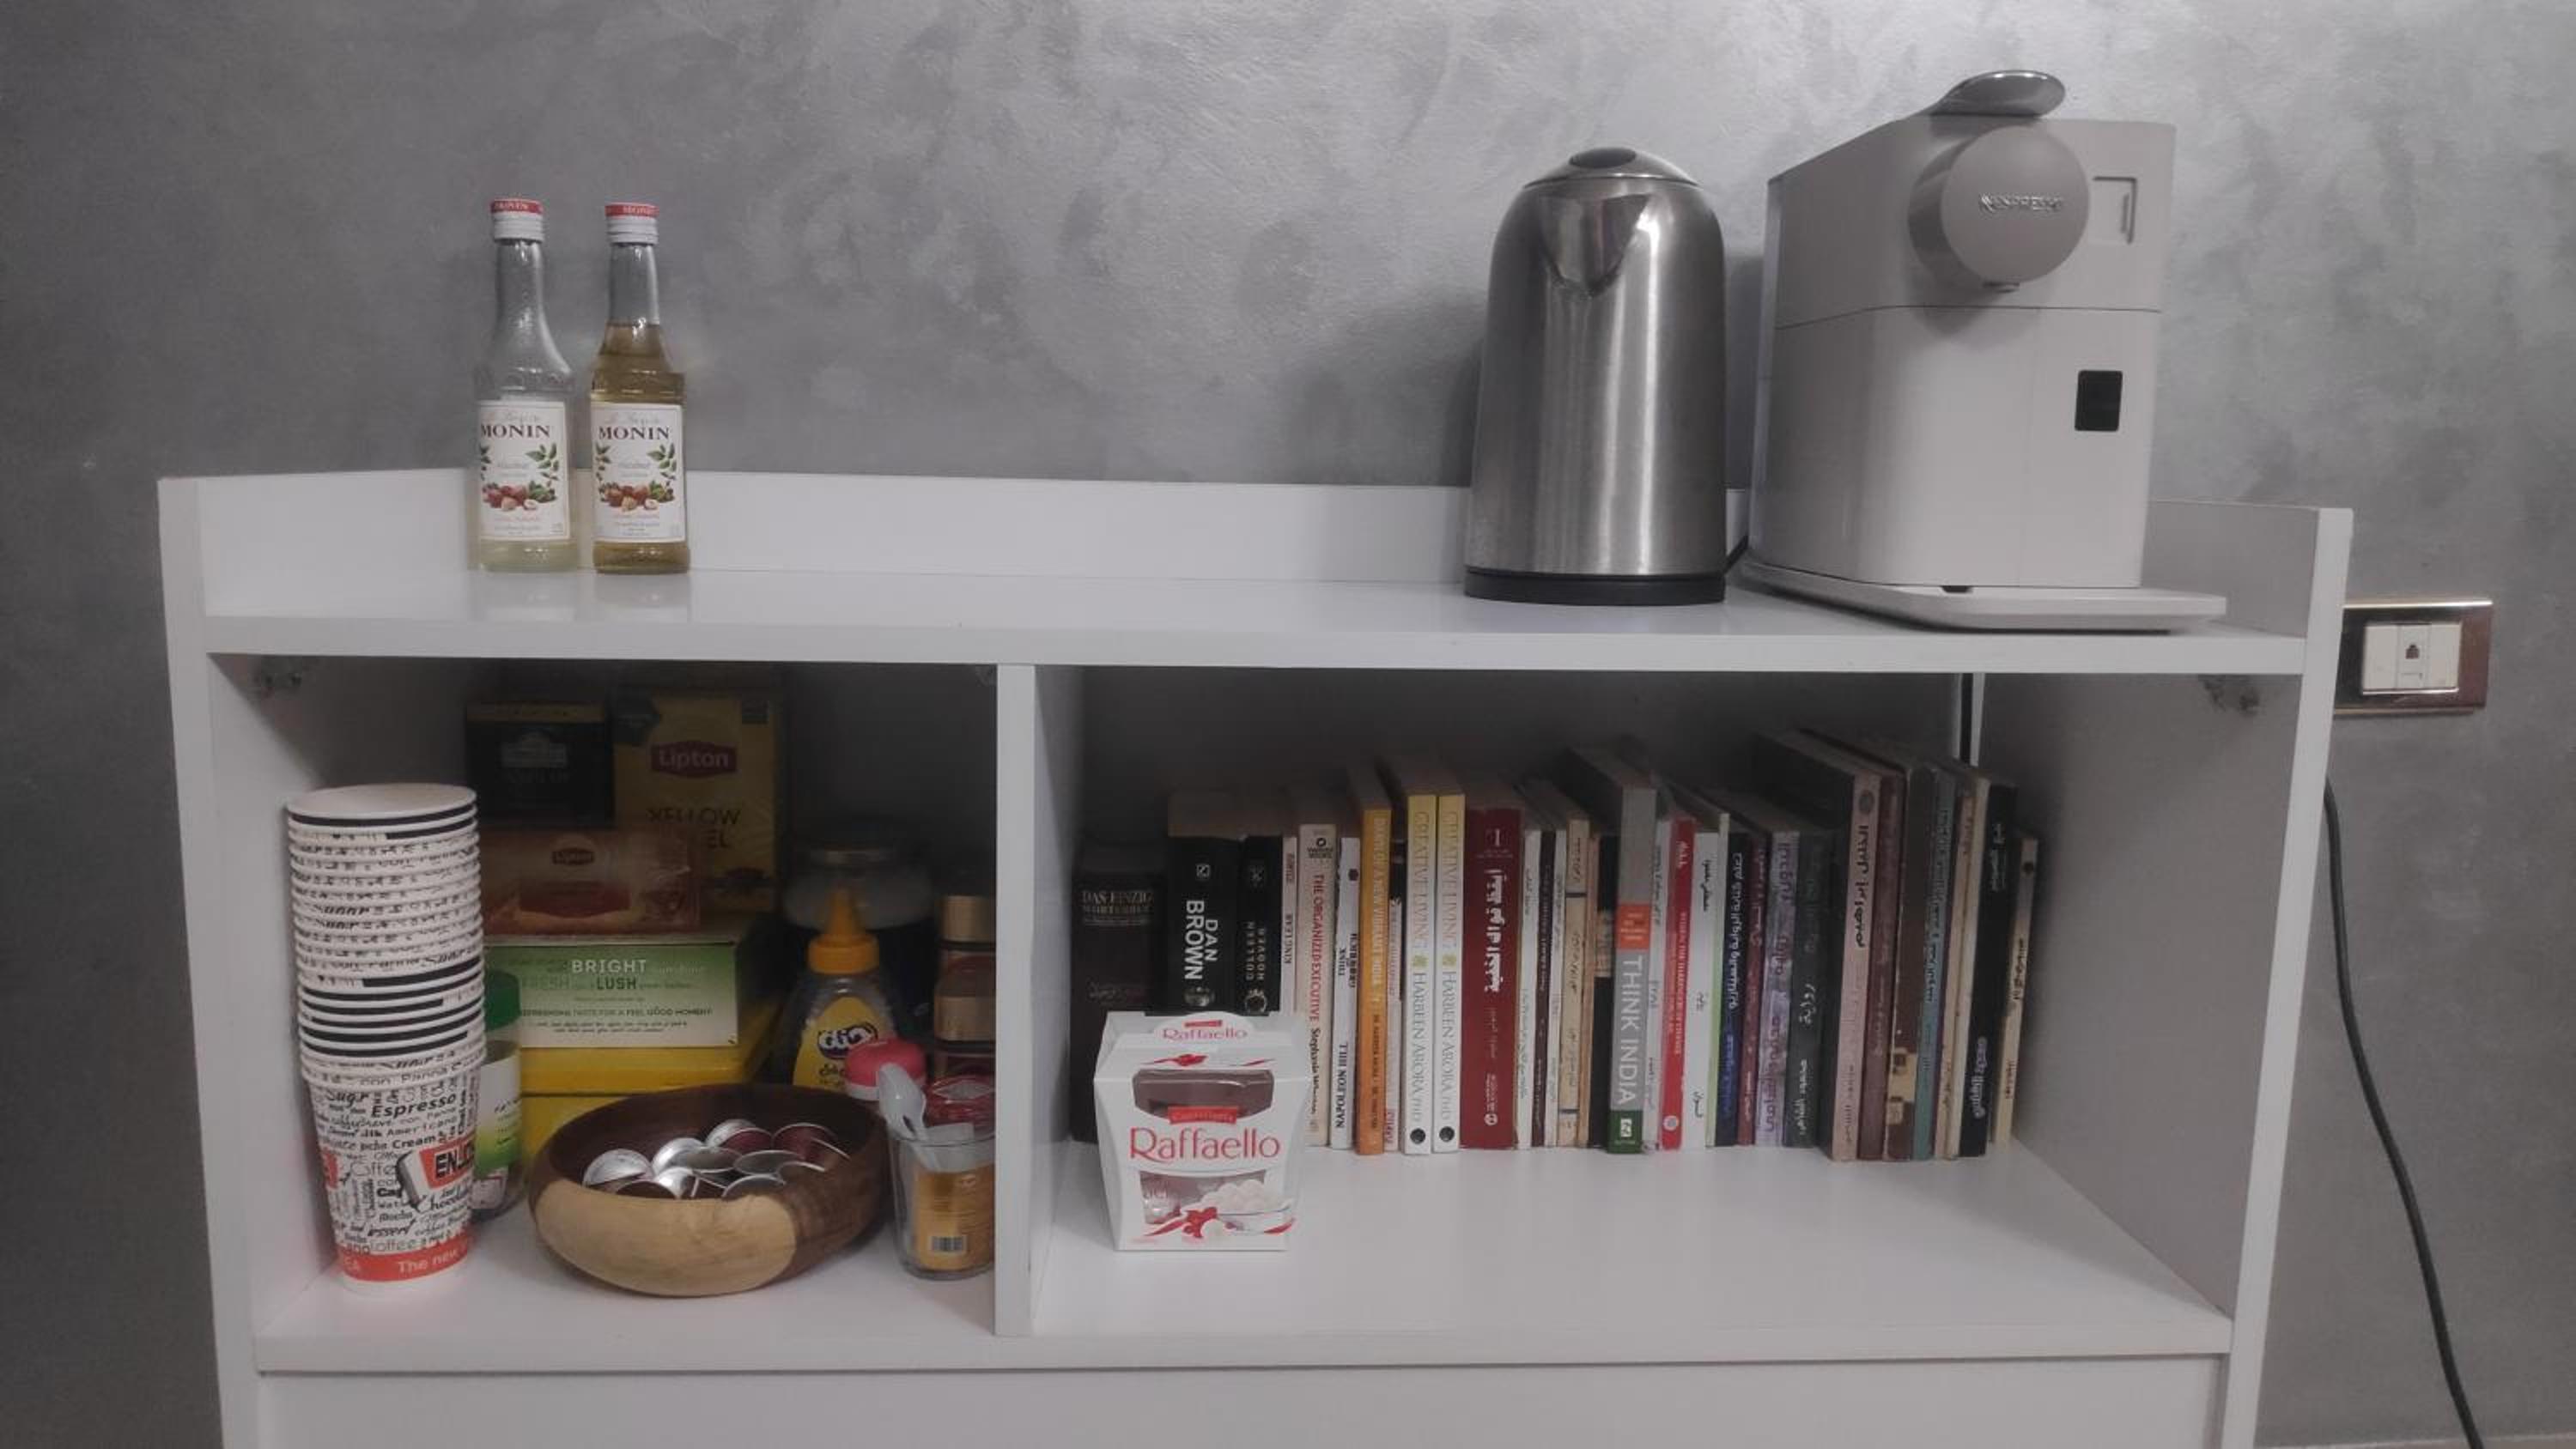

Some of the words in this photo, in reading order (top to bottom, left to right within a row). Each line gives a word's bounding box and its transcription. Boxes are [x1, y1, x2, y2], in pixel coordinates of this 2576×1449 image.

[481, 424, 550, 439] MONIN
[599, 426, 670, 440] MONIN
[658, 748, 730, 771] Lipton
[1413, 811, 1430, 889] CREATIVE
[1441, 810, 1458, 889] CREATIVE
[1732, 852, 1743, 880] تعلم
[1856, 825, 1870, 874] الخليل
[1312, 873, 1325, 895] THE
[1731, 882, 1742, 911] كتابة
[1310, 896, 1324, 962] ORGANIZED
[1413, 892, 1430, 949] LIVING
[1441, 892, 1458, 949] LIVING
[1729, 912, 1742, 950] الرواية
[1853, 882, 1869, 948] إبراهيم
[1183, 900, 1205, 980] BROWN
[1205, 919, 1218, 962] DAN
[571, 959, 647, 973] BRIGHT
[596, 977, 637, 990] LUSH
[1338, 947, 1346, 977] THINK
[1484, 947, 1504, 992] الخفية
[1309, 962, 1322, 1022] EXECUTIVE
[1413, 972, 1429, 1040] HARBEEN
[1441, 970, 1457, 1038] HARBEEN
[1621, 955, 1643, 1031] THINK
[1798, 983, 1816, 1026] رواية
[1163, 1028, 1249, 1043] Raffaello
[1339, 1042, 1347, 1068] HILL
[1413, 1042, 1428, 1093] ARORA
[1441, 1040, 1456, 1092] ARORA
[1617, 1039, 1639, 1105] INDIA
[371, 1093, 457, 1119] Espresso
[1335, 1070, 1346, 1129] NAPOLEON
[392, 1134, 436, 1149] Cream
[1128, 1126, 1281, 1163] Raffaello
[398, 1259, 428, 1273] The
